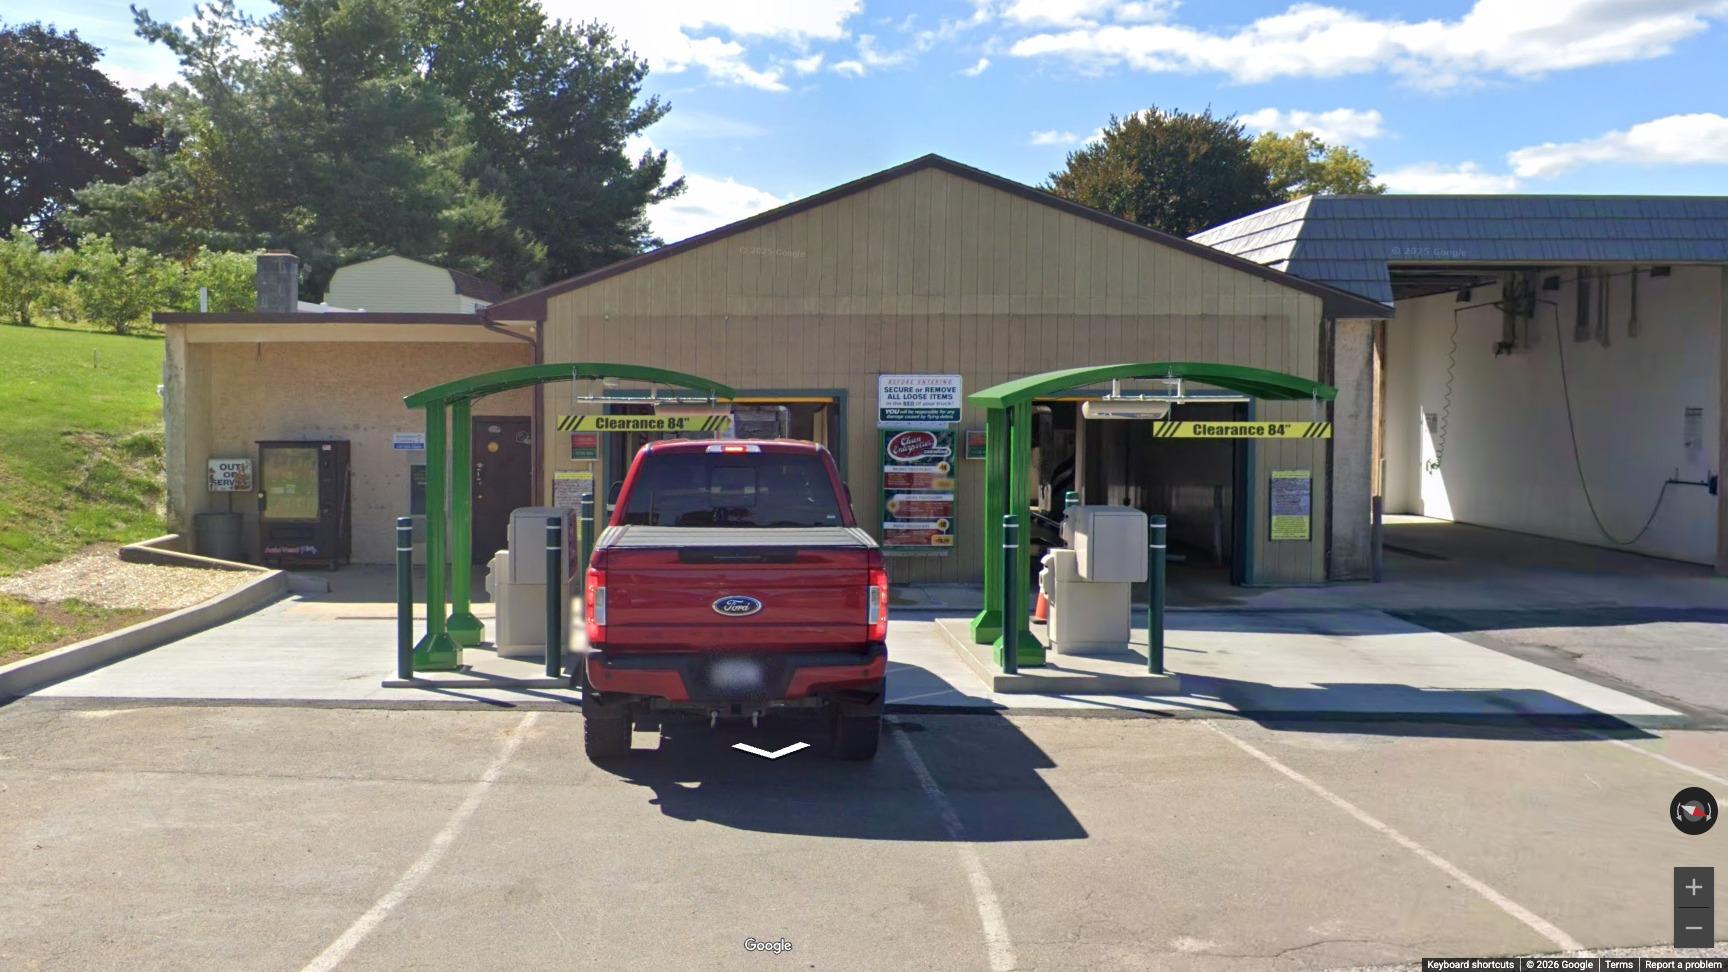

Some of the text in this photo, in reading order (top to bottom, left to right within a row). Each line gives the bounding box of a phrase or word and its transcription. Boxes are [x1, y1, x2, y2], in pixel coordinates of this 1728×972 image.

[595, 417, 690, 429] Clearance 84"
[1192, 424, 1291, 436] Clearance 84"
[723, 599, 750, 611] Ford
